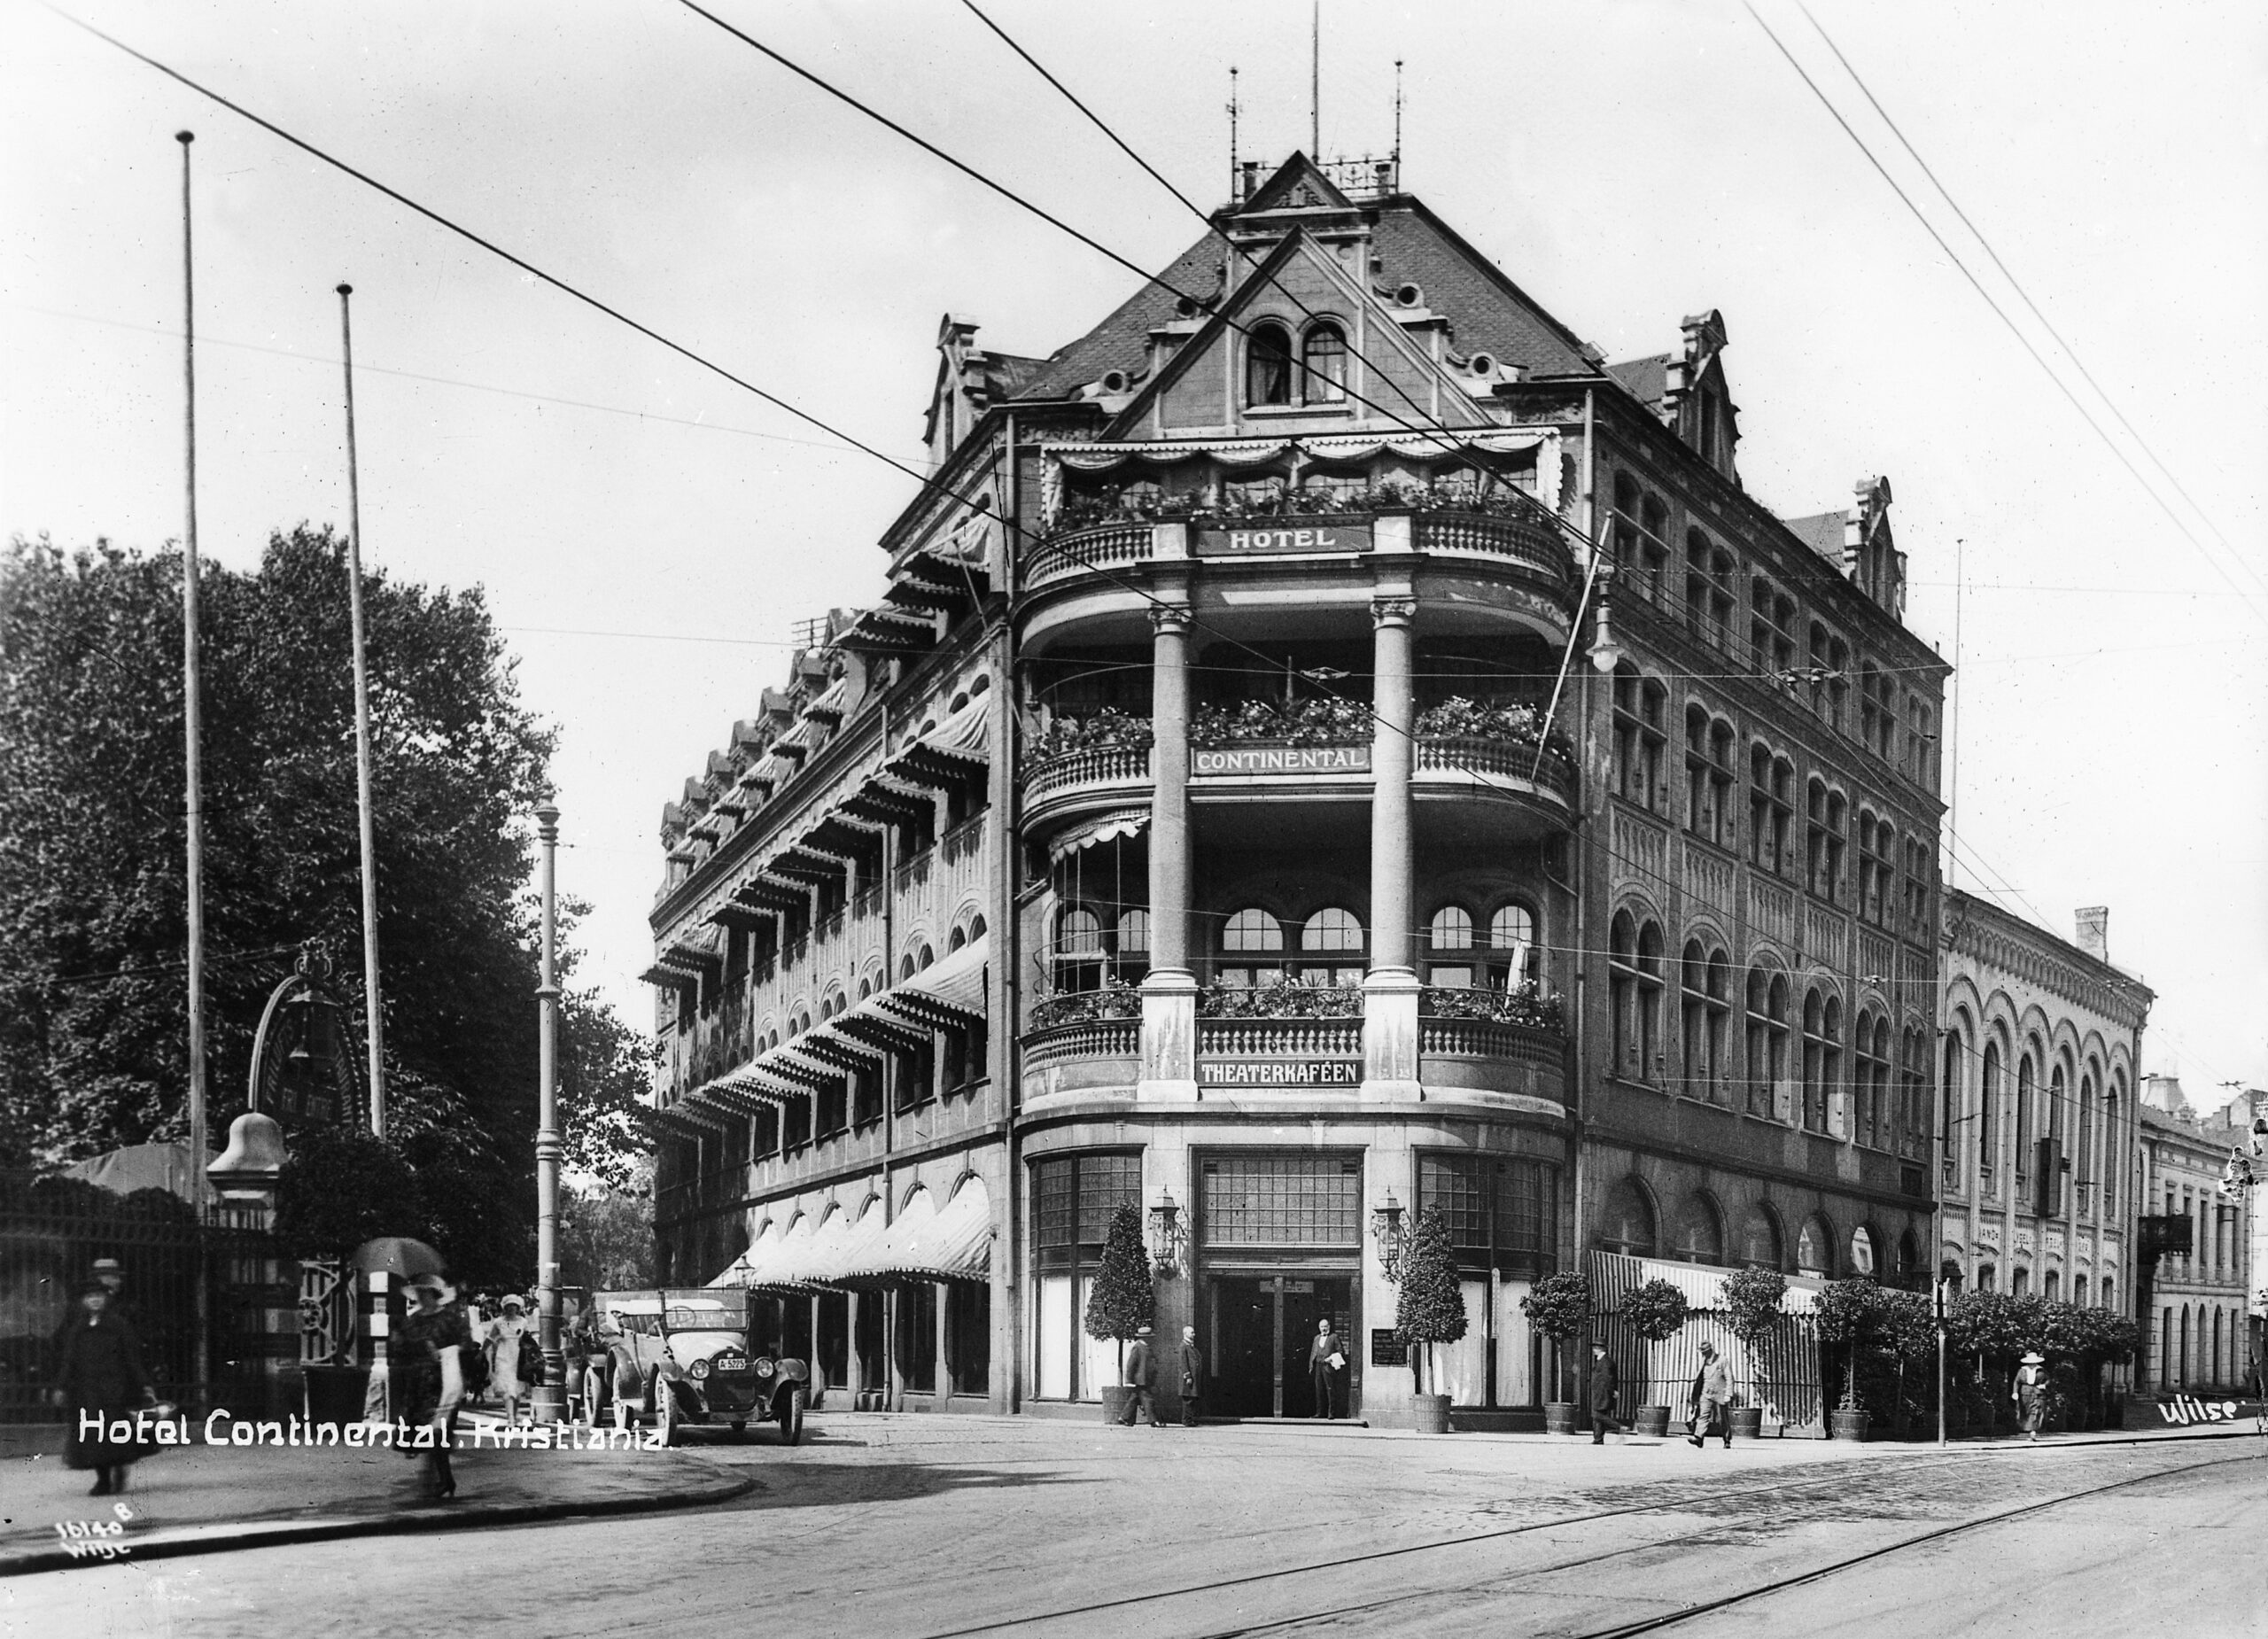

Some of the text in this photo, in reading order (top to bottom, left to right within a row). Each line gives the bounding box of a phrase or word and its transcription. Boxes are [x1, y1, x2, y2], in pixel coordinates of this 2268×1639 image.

[1231, 530, 1336, 548] HOTEL
[1197, 750, 1365, 771] CONTINENTAL
[1201, 1060, 1357, 1083] THEATERKAFÉEN
